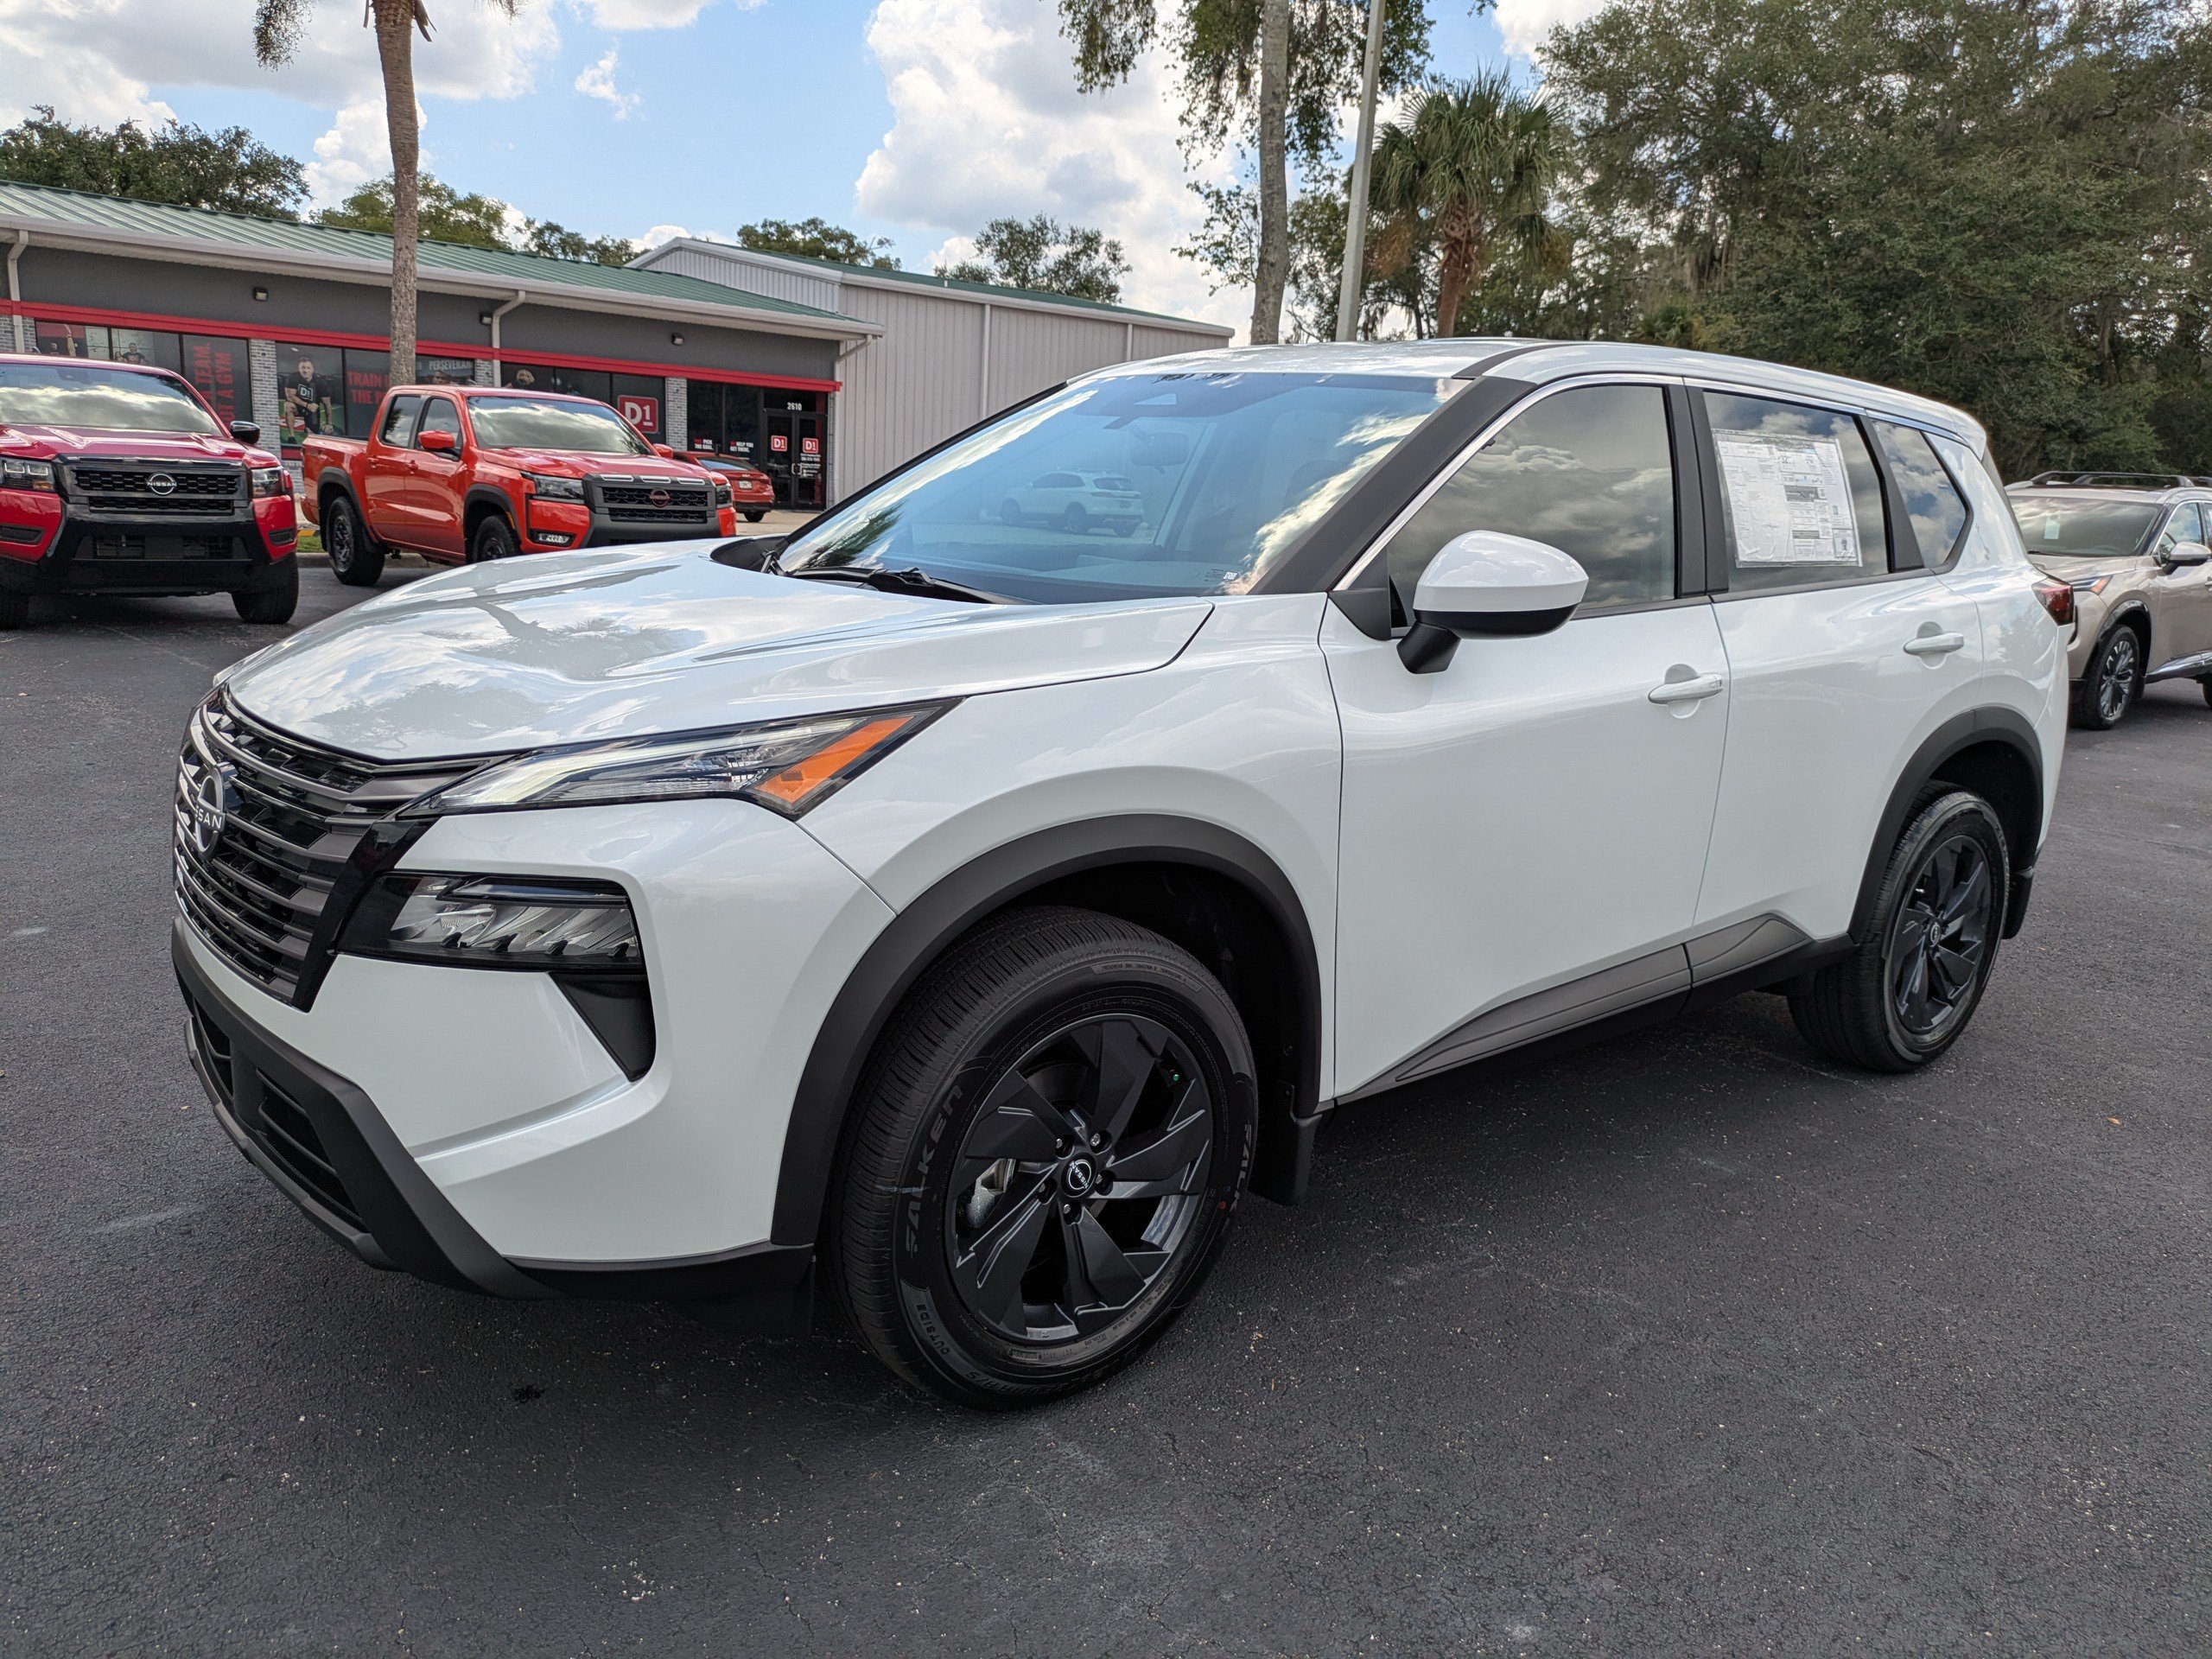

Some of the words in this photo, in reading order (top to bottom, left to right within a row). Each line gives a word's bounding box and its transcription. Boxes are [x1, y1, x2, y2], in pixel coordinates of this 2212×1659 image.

[214, 351, 233, 385] GYM
[346, 370, 382, 388] TRAIN
[217, 389, 234, 399] A
[625, 401, 654, 427] D1
[787, 402, 803, 411] 2610
[773, 438, 785, 448] D1
[805, 440, 817, 451] D1
[1069, 1160, 1089, 1189] NISSAN
[916, 1303, 950, 1355] OUTSIDE
